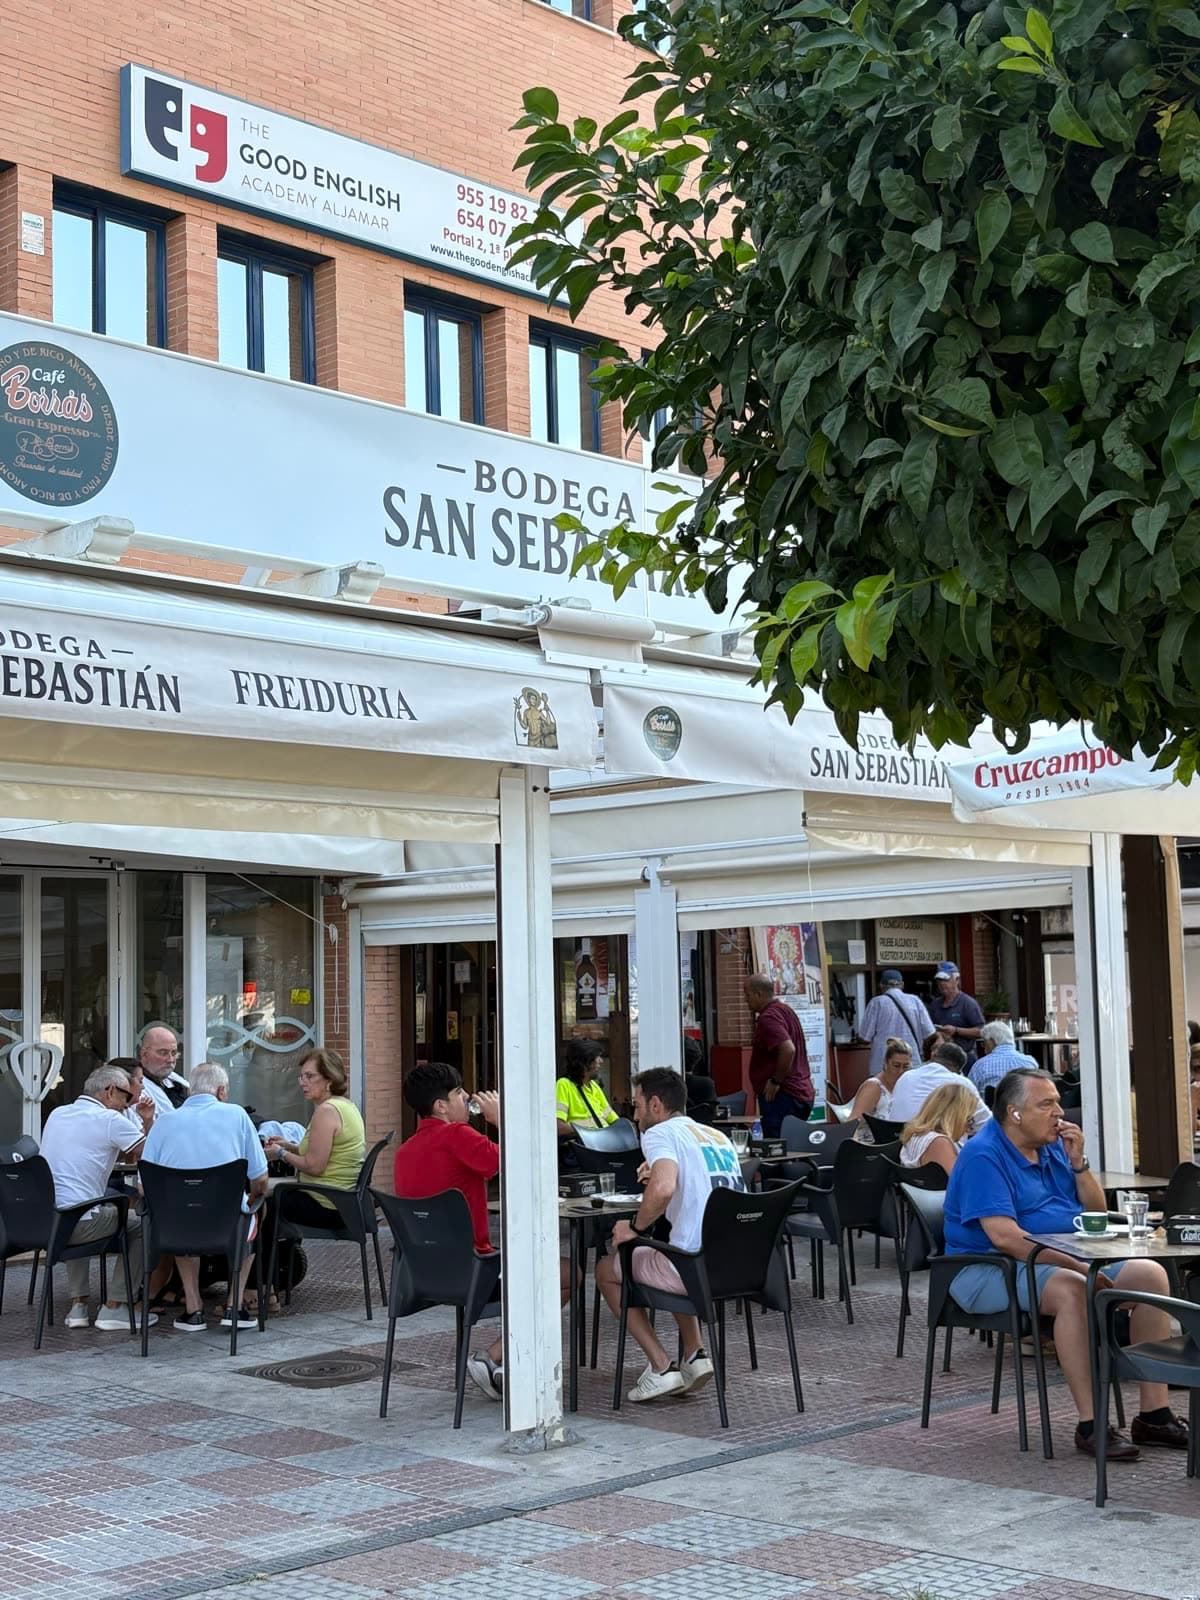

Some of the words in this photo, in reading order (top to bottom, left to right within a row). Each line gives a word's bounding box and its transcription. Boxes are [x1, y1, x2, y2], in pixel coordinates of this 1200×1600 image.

[240, 117, 271, 140] THE
[239, 143, 307, 181] GOOD
[313, 166, 401, 213] ENGLISH
[240, 174, 318, 209] ACADEMY
[322, 200, 390, 232] ALJAMAR
[456, 184, 484, 208] 955
[489, 195, 507, 215] 19
[510, 202, 528, 222] 82
[456, 208, 485, 232] 654
[488, 219, 507, 238] 07
[443, 227, 474, 248] Portal
[13, 350, 20, 360] Y
[23, 347, 38, 357] DE
[40, 347, 64, 362] RICO
[66, 358, 97, 390] AROMA
[31, 368, 66, 386] Café
[4, 411, 35, 427] Gran
[37, 418, 90, 438] Espresso
[474, 459, 637, 524] BODEGA
[382, 485, 476, 561] SAN
[229, 669, 418, 721] FREIDURIA
[810, 746, 849, 780] SAN
[855, 752, 952, 789] SEBASTIÁN
[974, 746, 1123, 789] Cruzcampo
[1005, 785, 1050, 800] DESDE
